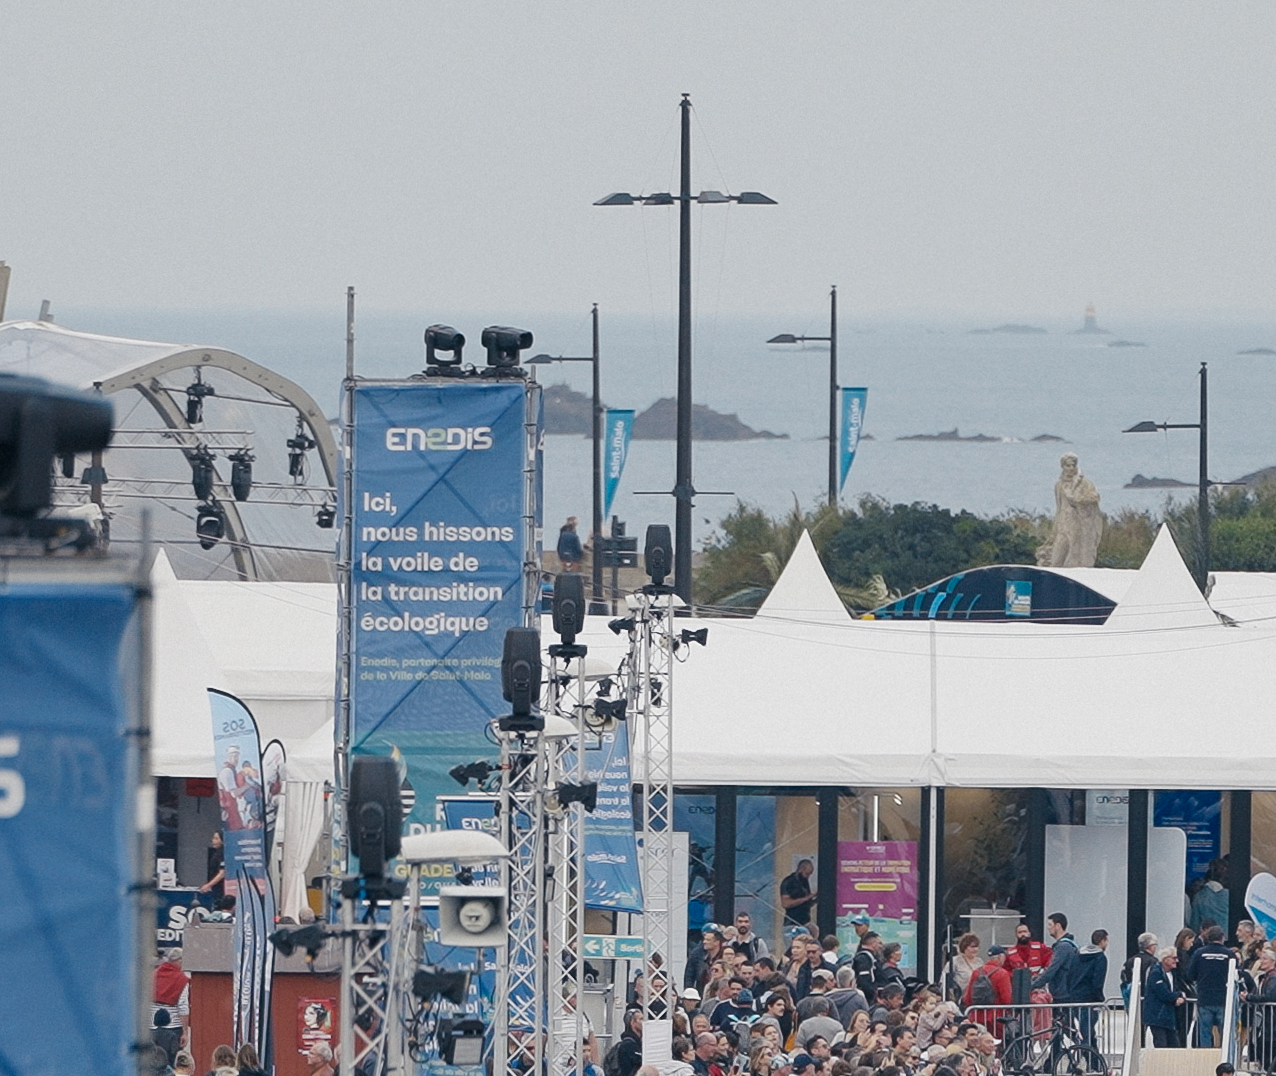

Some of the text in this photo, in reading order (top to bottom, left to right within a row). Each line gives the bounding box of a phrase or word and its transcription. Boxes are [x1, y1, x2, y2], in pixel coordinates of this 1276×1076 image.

[364, 493, 398, 515] Ici,
[362, 522, 514, 542] nous hissons
[361, 553, 479, 571] la voile de
[361, 582, 502, 601] la transition
[361, 612, 489, 636] écologique
[461, 656, 503, 668] privilég
[361, 671, 374, 680] de
[377, 671, 386, 680] la
[389, 671, 413, 680] Ville
